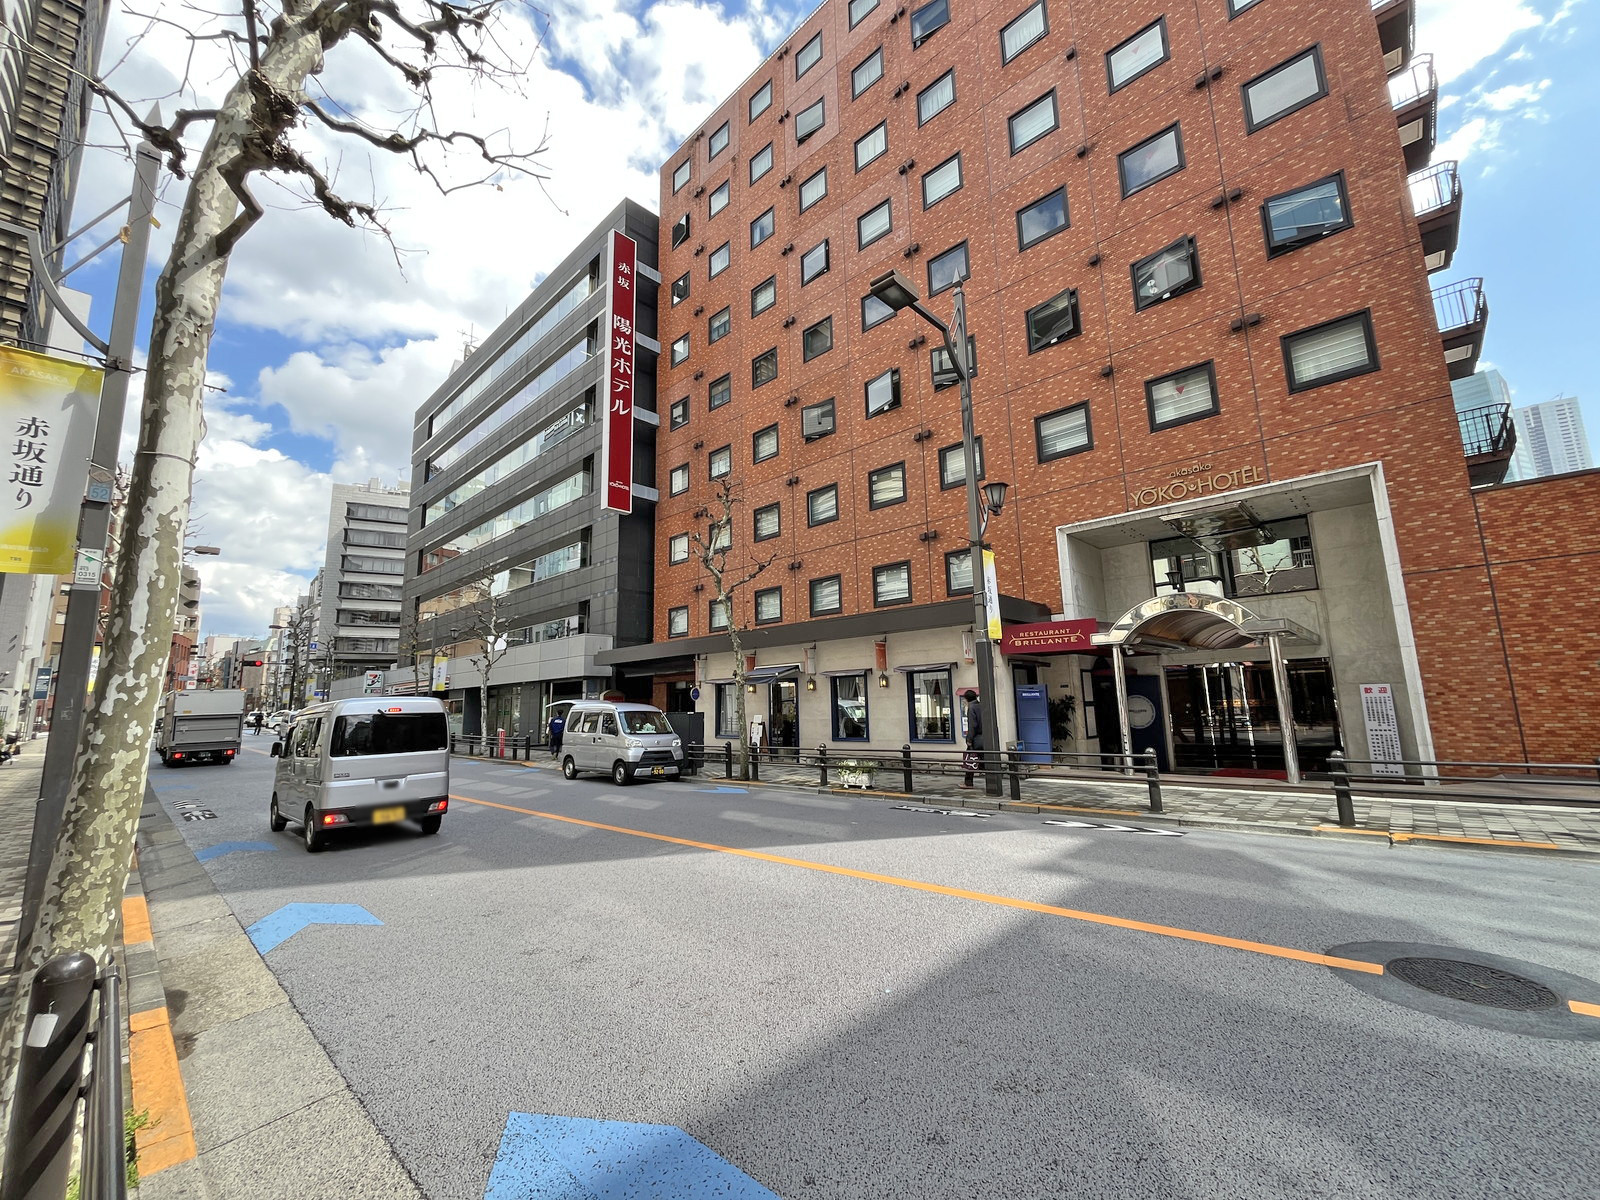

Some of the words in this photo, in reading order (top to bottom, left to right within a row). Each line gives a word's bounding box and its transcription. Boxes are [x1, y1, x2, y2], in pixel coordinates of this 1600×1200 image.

[618, 262, 631, 290] 赤坂
[610, 314, 632, 415] 陽光ホテル
[8, 416, 51, 510] 赤坂通り
[1169, 462, 1212, 478] akasaka
[1198, 466, 1264, 494] HOTEL
[91, 487, 109, 500] 52
[1015, 636, 1078, 647] BRILLANTE
[1019, 628, 1071, 638] RESTAURANT
